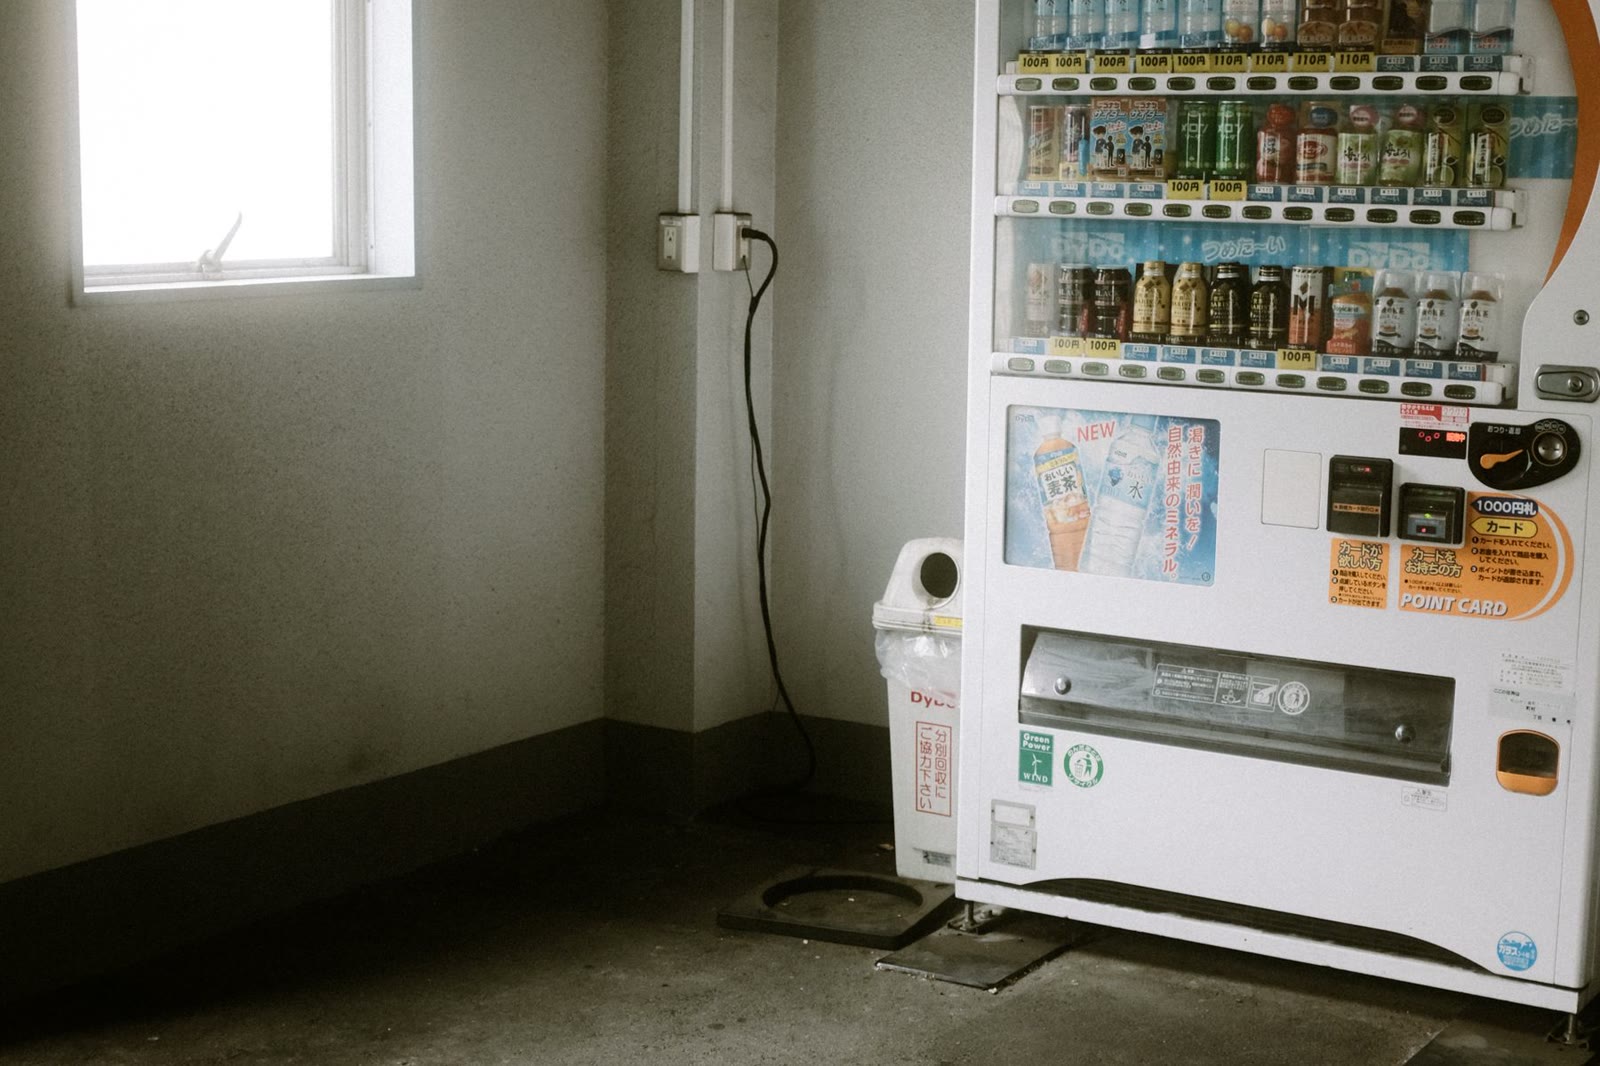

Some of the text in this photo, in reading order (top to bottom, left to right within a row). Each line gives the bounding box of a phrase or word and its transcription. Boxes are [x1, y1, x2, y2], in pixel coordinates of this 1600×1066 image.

[1022, 55, 1049, 68] 100円
[1054, 55, 1082, 68] 100円
[1098, 55, 1126, 68] 100円
[1140, 55, 1168, 68] 100円
[1177, 55, 1206, 67] 100円
[1214, 54, 1243, 66] 110円
[1255, 54, 1284, 66] 110円
[1297, 53, 1327, 66] 110円
[1339, 53, 1370, 66] 110円
[1171, 181, 1199, 192] 100円
[1214, 181, 1242, 193] 100円
[1054, 338, 1080, 350] 100円
[1090, 339, 1117, 351] 100円
[1282, 350, 1311, 363] 100円
[1077, 421, 1116, 443] NEW
[1044, 465, 1073, 482] おいしい
[1047, 475, 1078, 498] 麦茶
[1127, 481, 1143, 500] 水
[1163, 426, 1182, 580] 自然由来のミネラル。
[1477, 499, 1536, 516] 1000円札
[1486, 520, 1523, 535] カード
[1340, 541, 1382, 557] カードが
[1412, 547, 1456, 563] カードを
[1338, 555, 1382, 571] 欲しい方
[1405, 560, 1463, 578] お持ちの方
[1401, 593, 1508, 616] POINT CARD
[1023, 733, 1050, 745] Green
[1022, 740, 1051, 752] Power
[935, 729, 947, 799] 分別回収に
[1023, 772, 1048, 783] WIND
